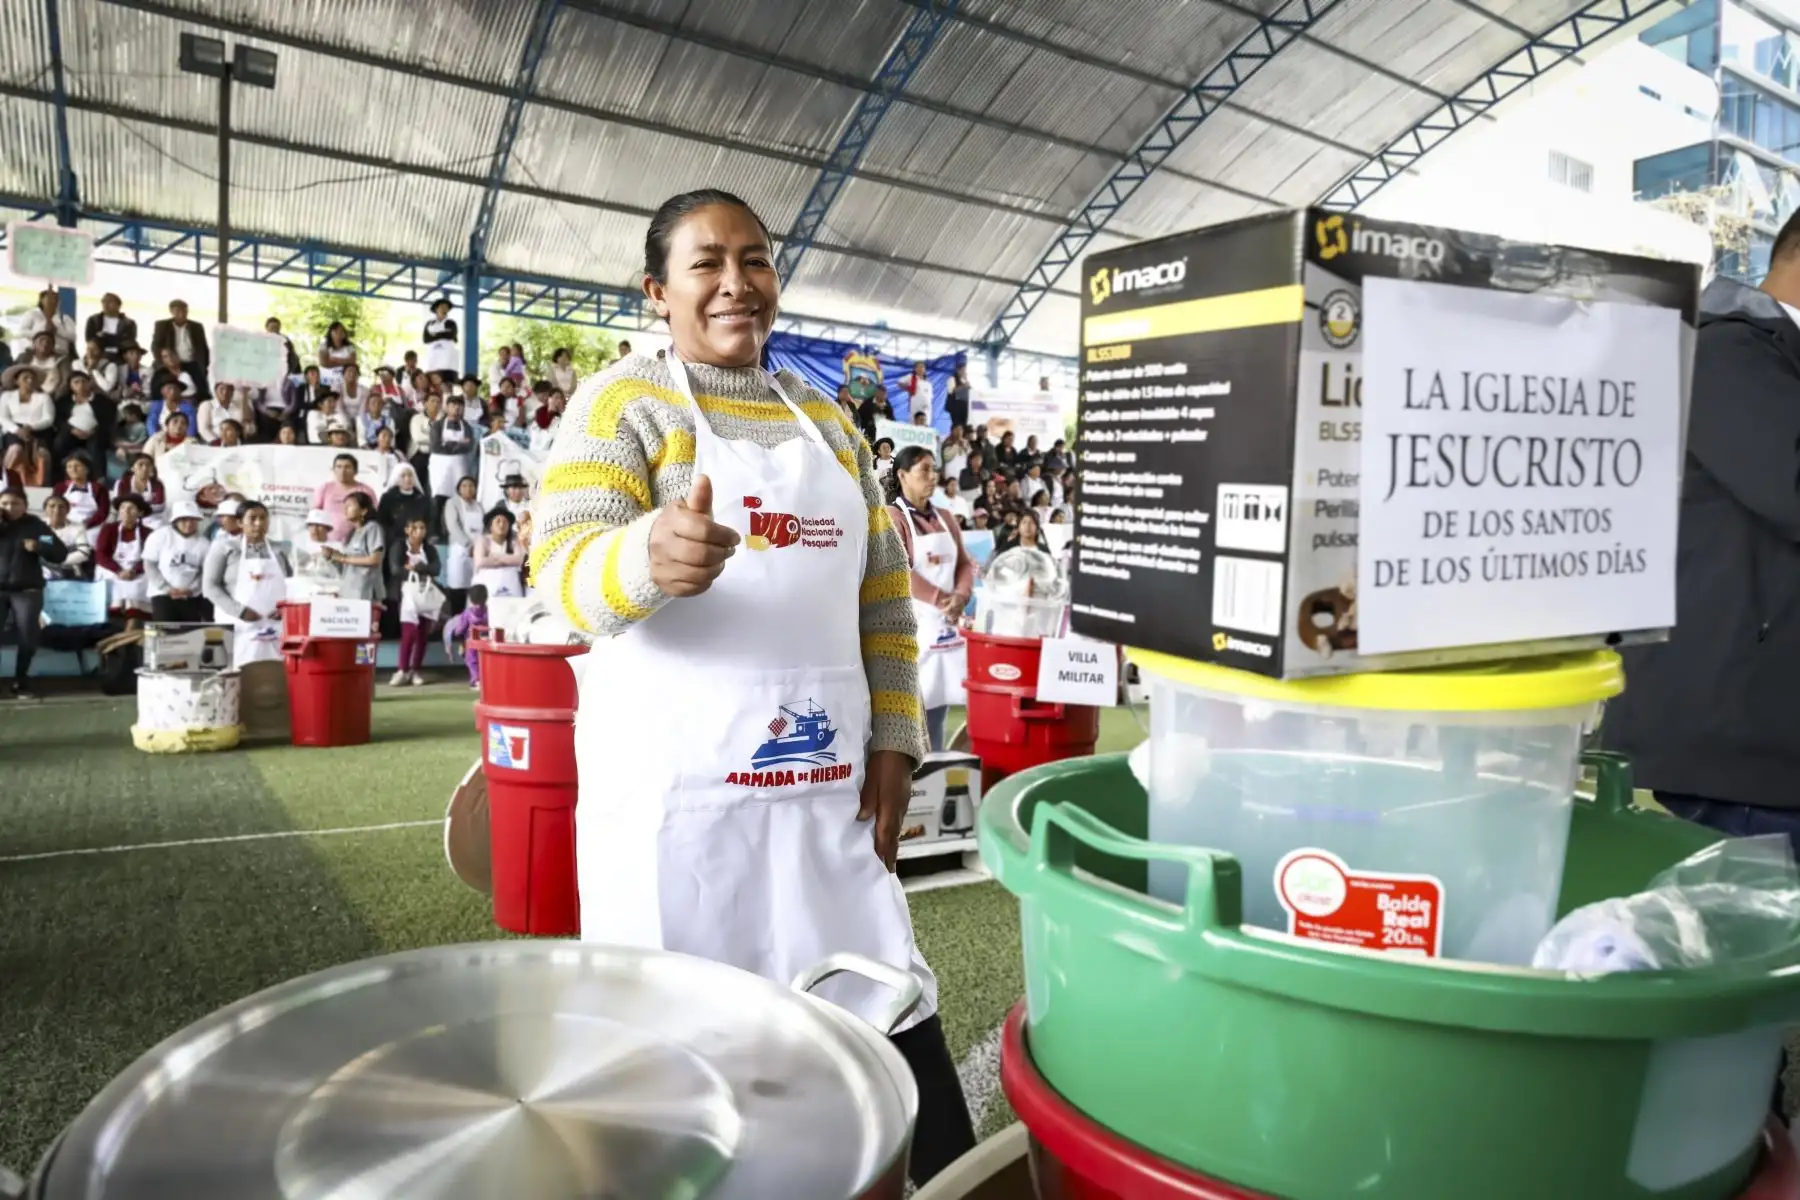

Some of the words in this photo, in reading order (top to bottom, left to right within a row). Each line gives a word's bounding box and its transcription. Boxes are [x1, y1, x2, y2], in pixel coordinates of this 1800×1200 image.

[1352, 221, 1445, 262] imaco
[1112, 260, 1185, 293] imaco
[1336, 305, 1346, 320] 2
[1403, 368, 1449, 410] LA
[1461, 371, 1590, 417] IGLESIA
[1597, 378, 1636, 418] DE
[1383, 432, 1643, 502] JESUCRISTO
[801, 516, 835, 526] Sociedad
[801, 527, 834, 536] Nacional
[835, 528, 844, 537] de
[1422, 510, 1458, 539] DE
[1468, 509, 1514, 538] LOS
[1521, 507, 1612, 535] SANTOS
[1373, 558, 1410, 588] DE
[1421, 556, 1471, 585] LOS
[1481, 546, 1589, 582] ÚLTIMOS
[1596, 542, 1647, 575] DÍAS
[1068, 651, 1098, 665] VILLA
[1058, 670, 1105, 685] MILITAR
[725, 770, 796, 787] ARMADA
[797, 772, 809, 782] DE
[810, 762, 852, 784] HIERRO
[1377, 893, 1431, 911] Balde
